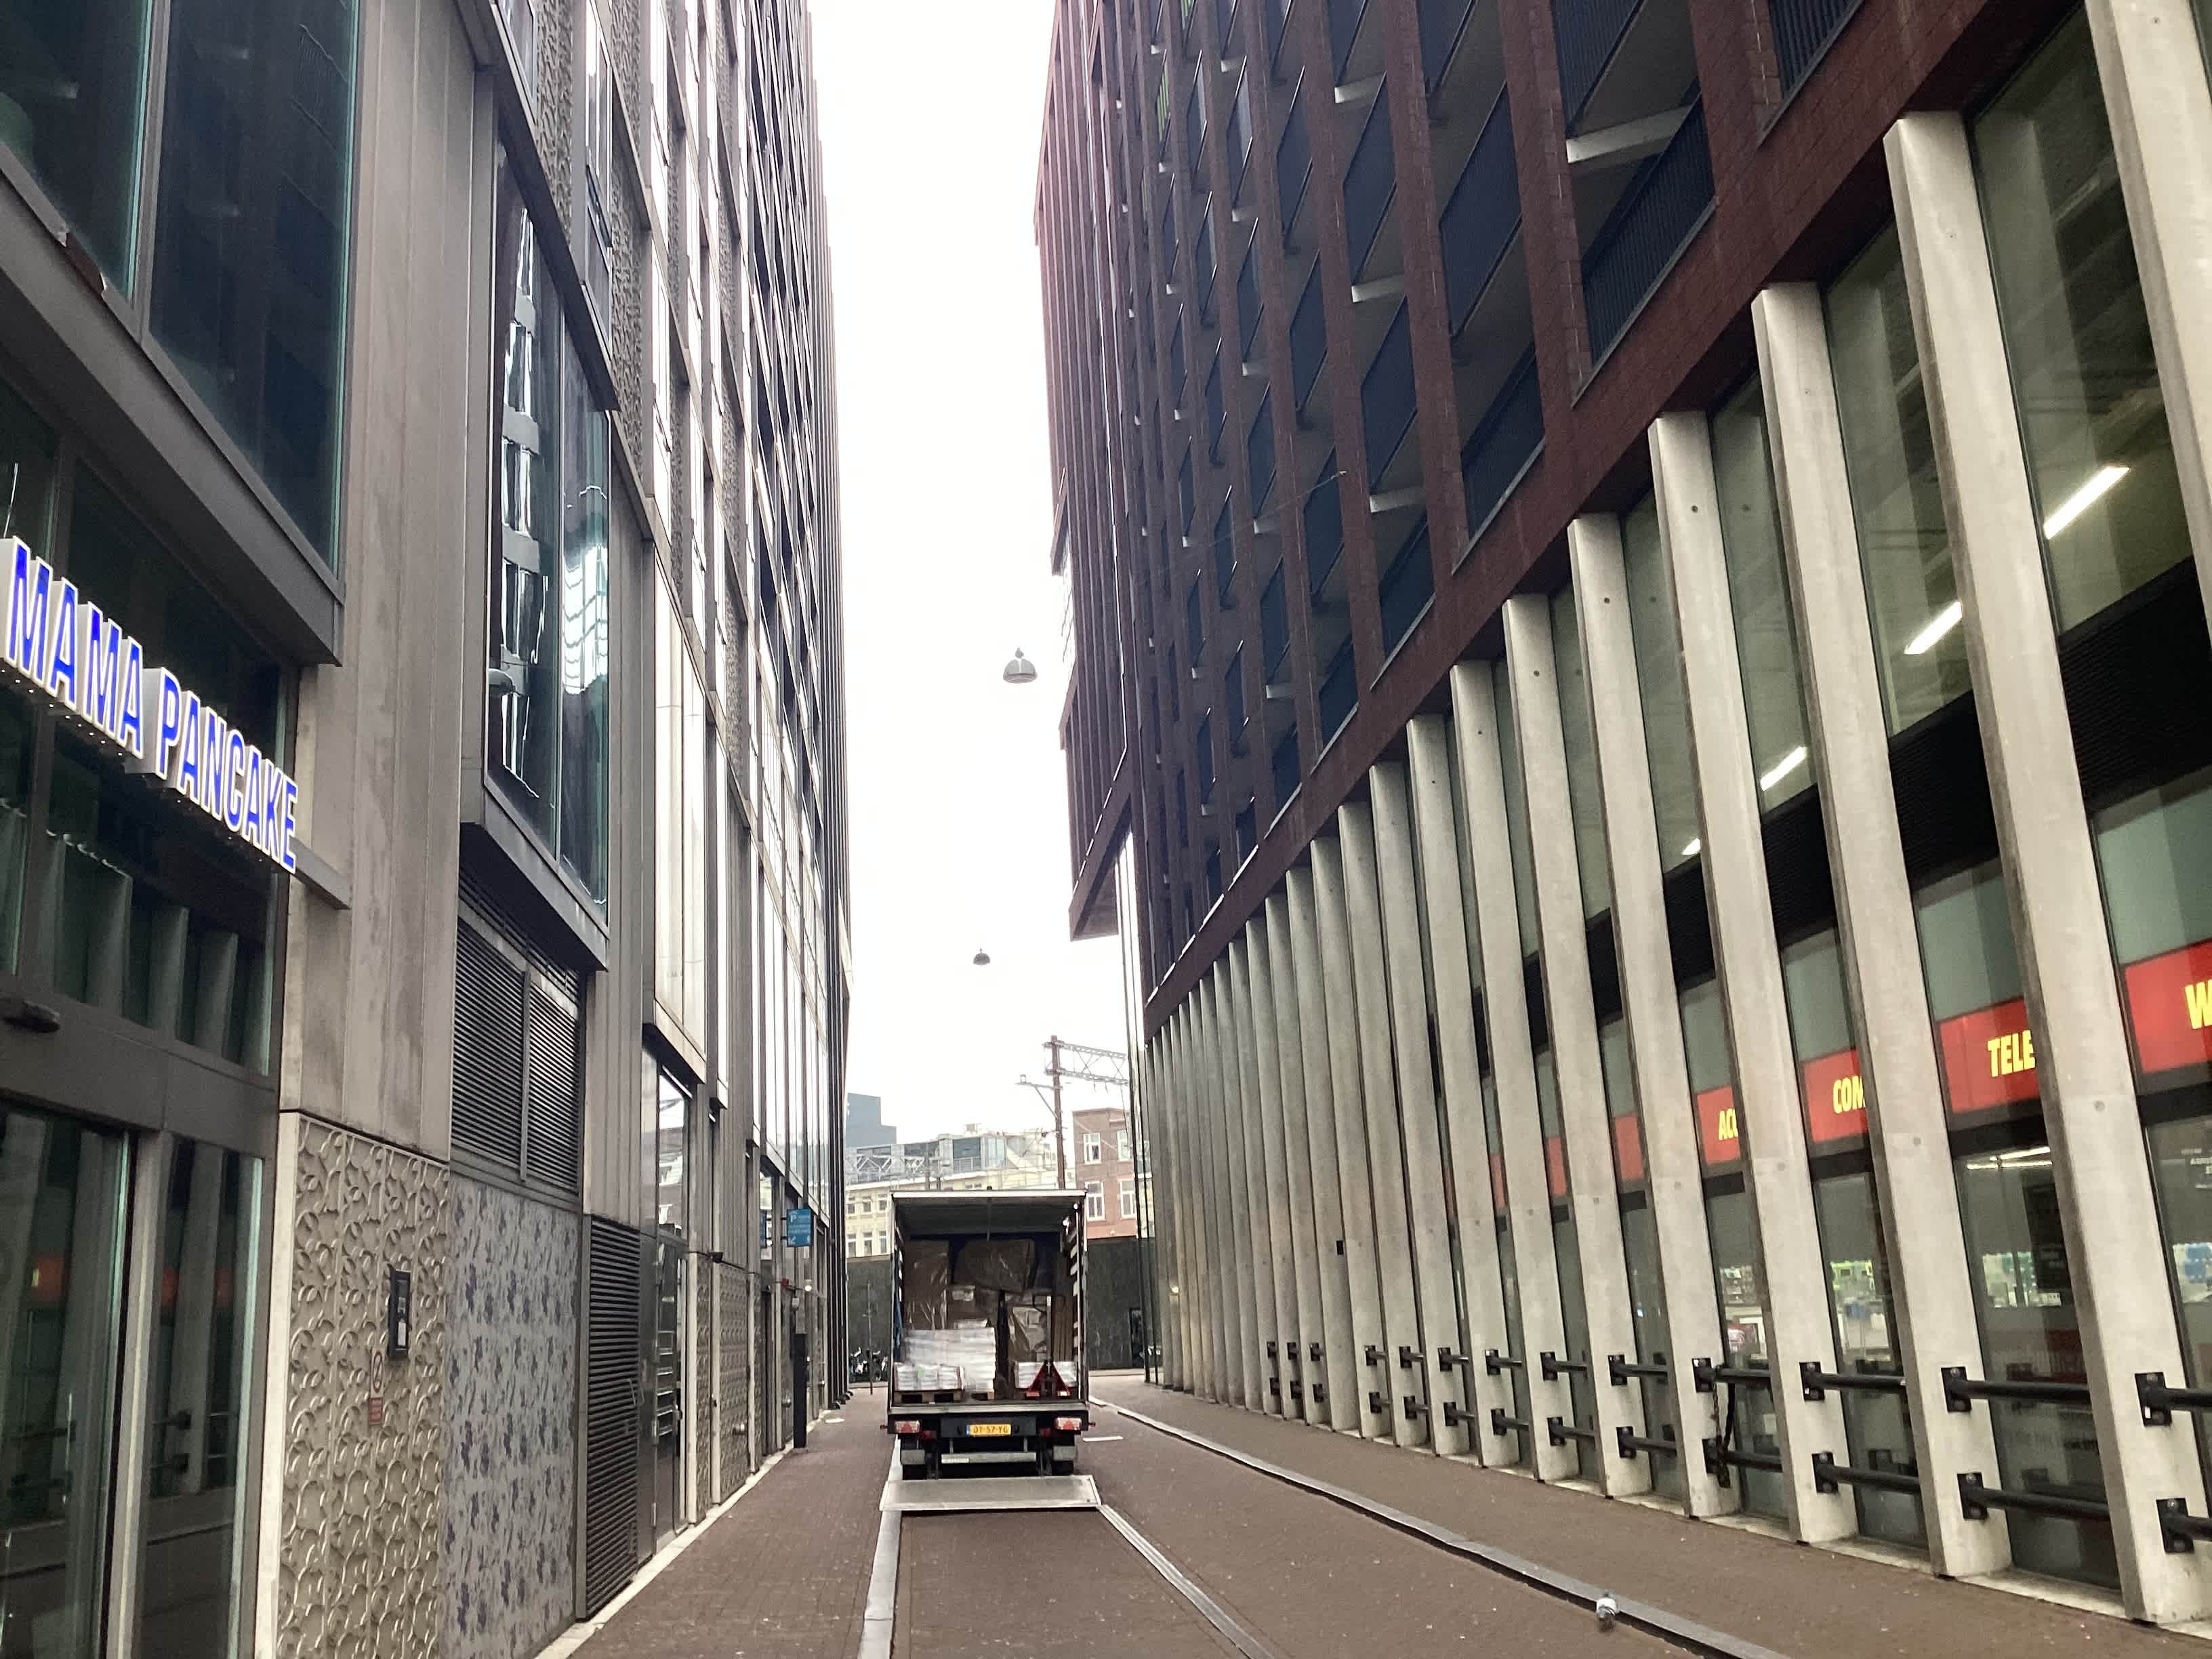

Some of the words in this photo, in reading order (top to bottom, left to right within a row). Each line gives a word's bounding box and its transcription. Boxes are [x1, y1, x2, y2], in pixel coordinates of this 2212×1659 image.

[5, 536, 143, 759] MAMA
[156, 667, 298, 874] PANCAKE
[1988, 1030, 2036, 1077] TELE
